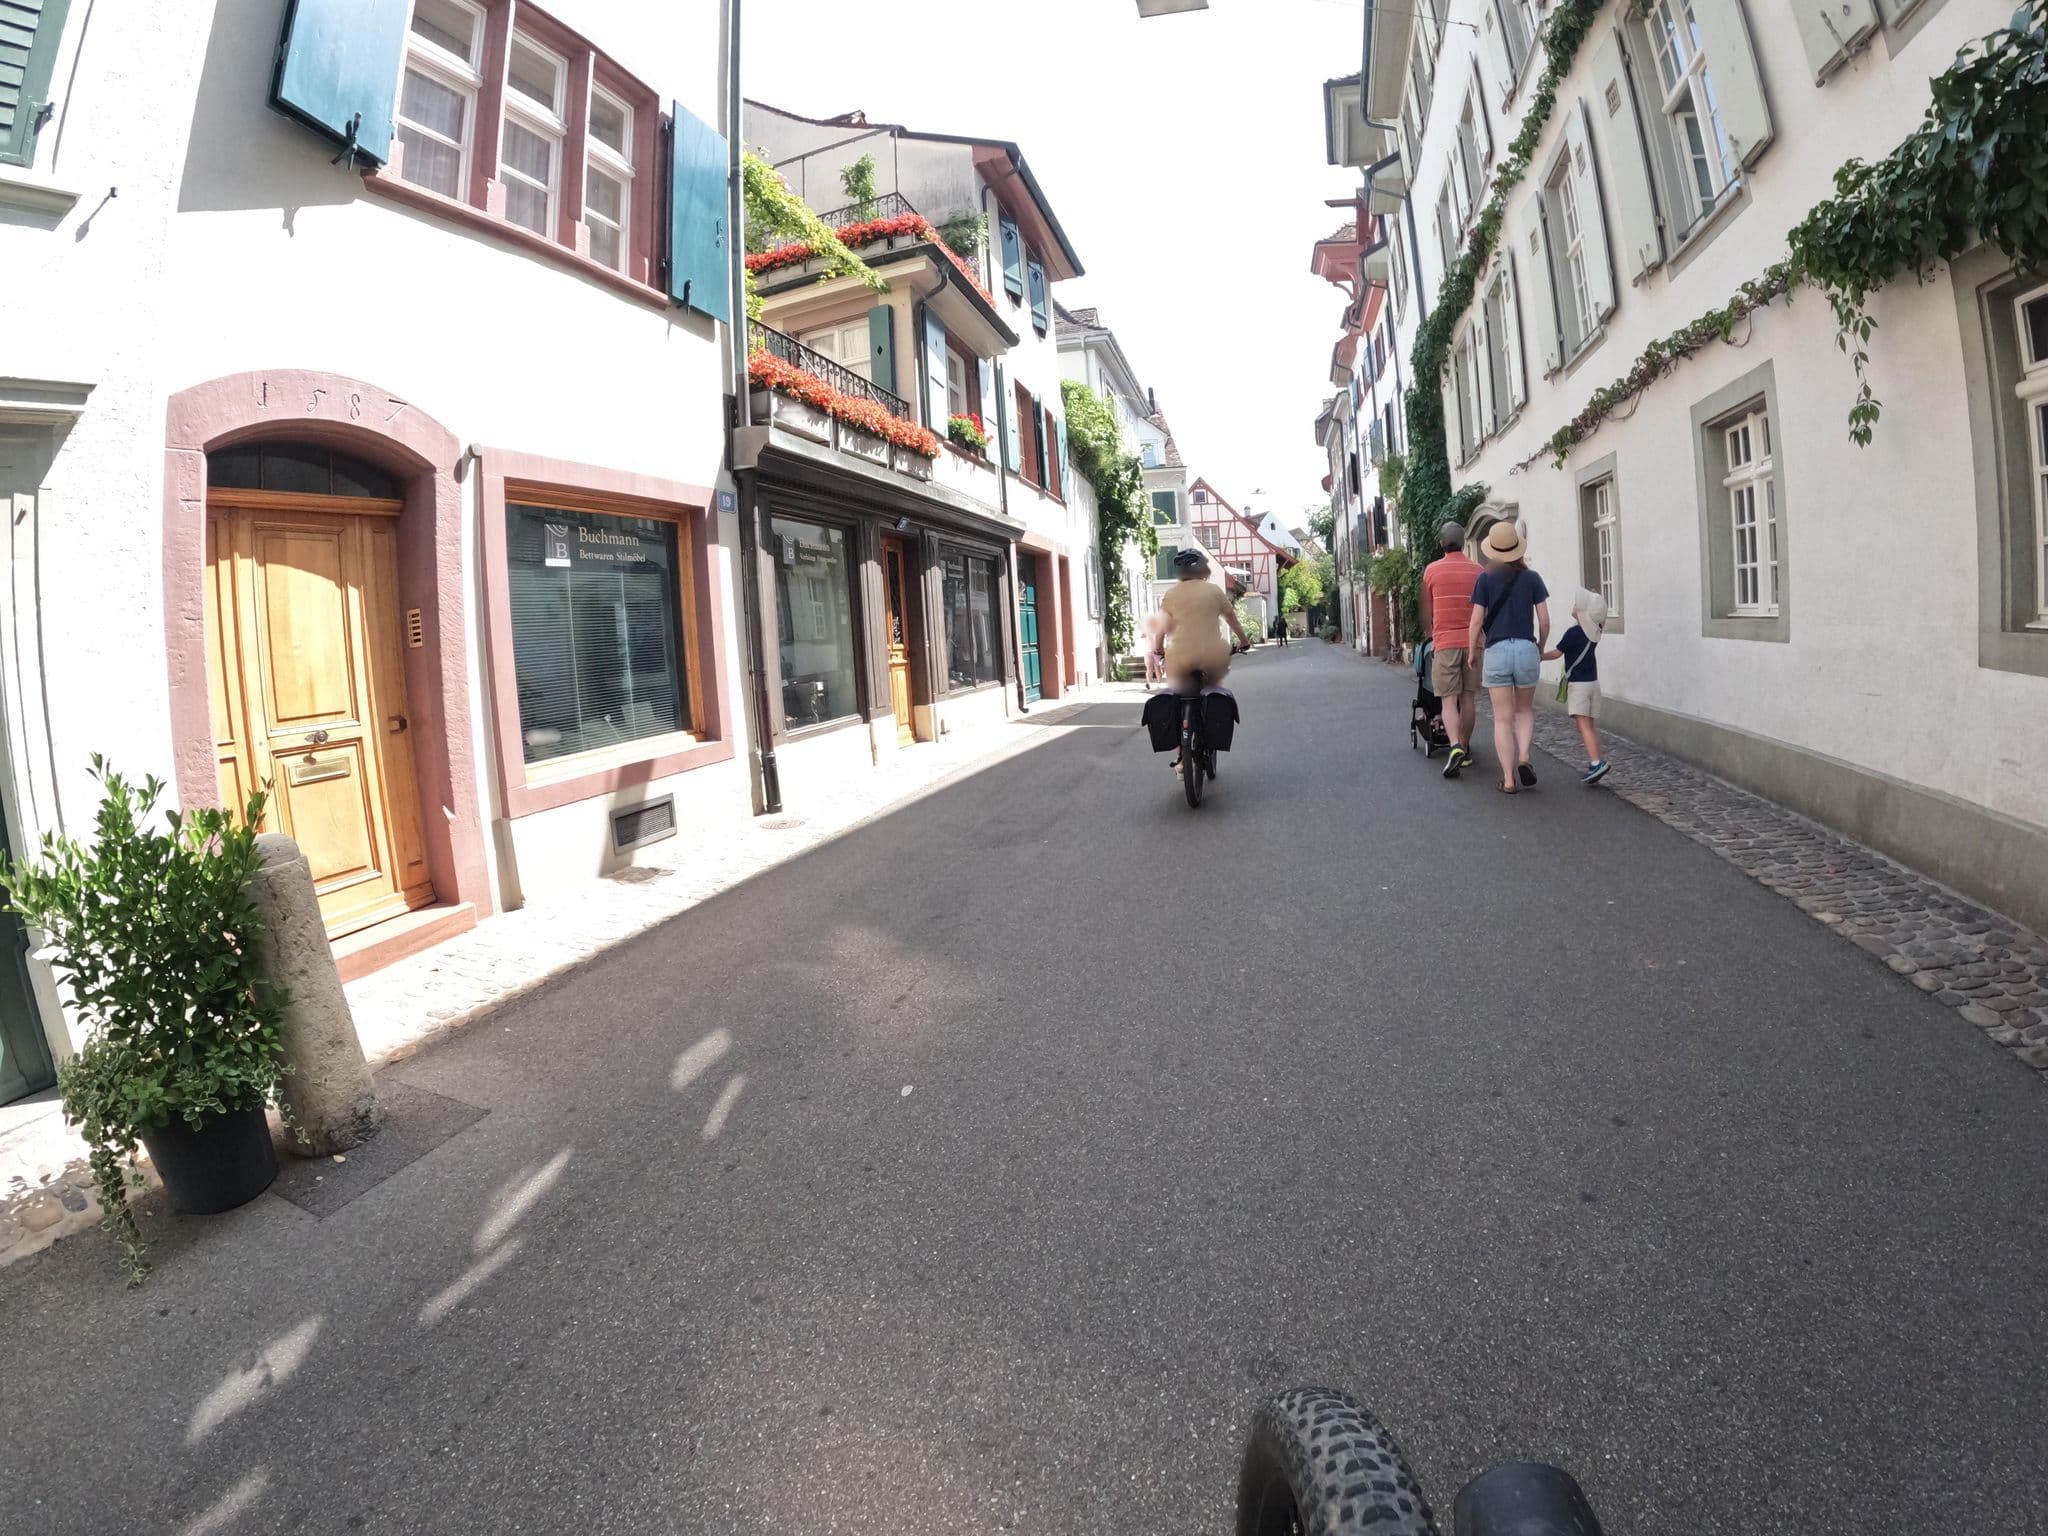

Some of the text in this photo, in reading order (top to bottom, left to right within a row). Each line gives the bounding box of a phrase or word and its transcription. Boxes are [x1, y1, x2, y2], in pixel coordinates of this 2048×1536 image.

[257, 382, 408, 422] 1587
[722, 495, 731, 508] 19
[578, 526, 640, 546] Buchmann
[555, 542, 568, 558] B
[579, 549, 646, 562] Bettwaren Stilmöbel
[788, 547, 795, 559] B
